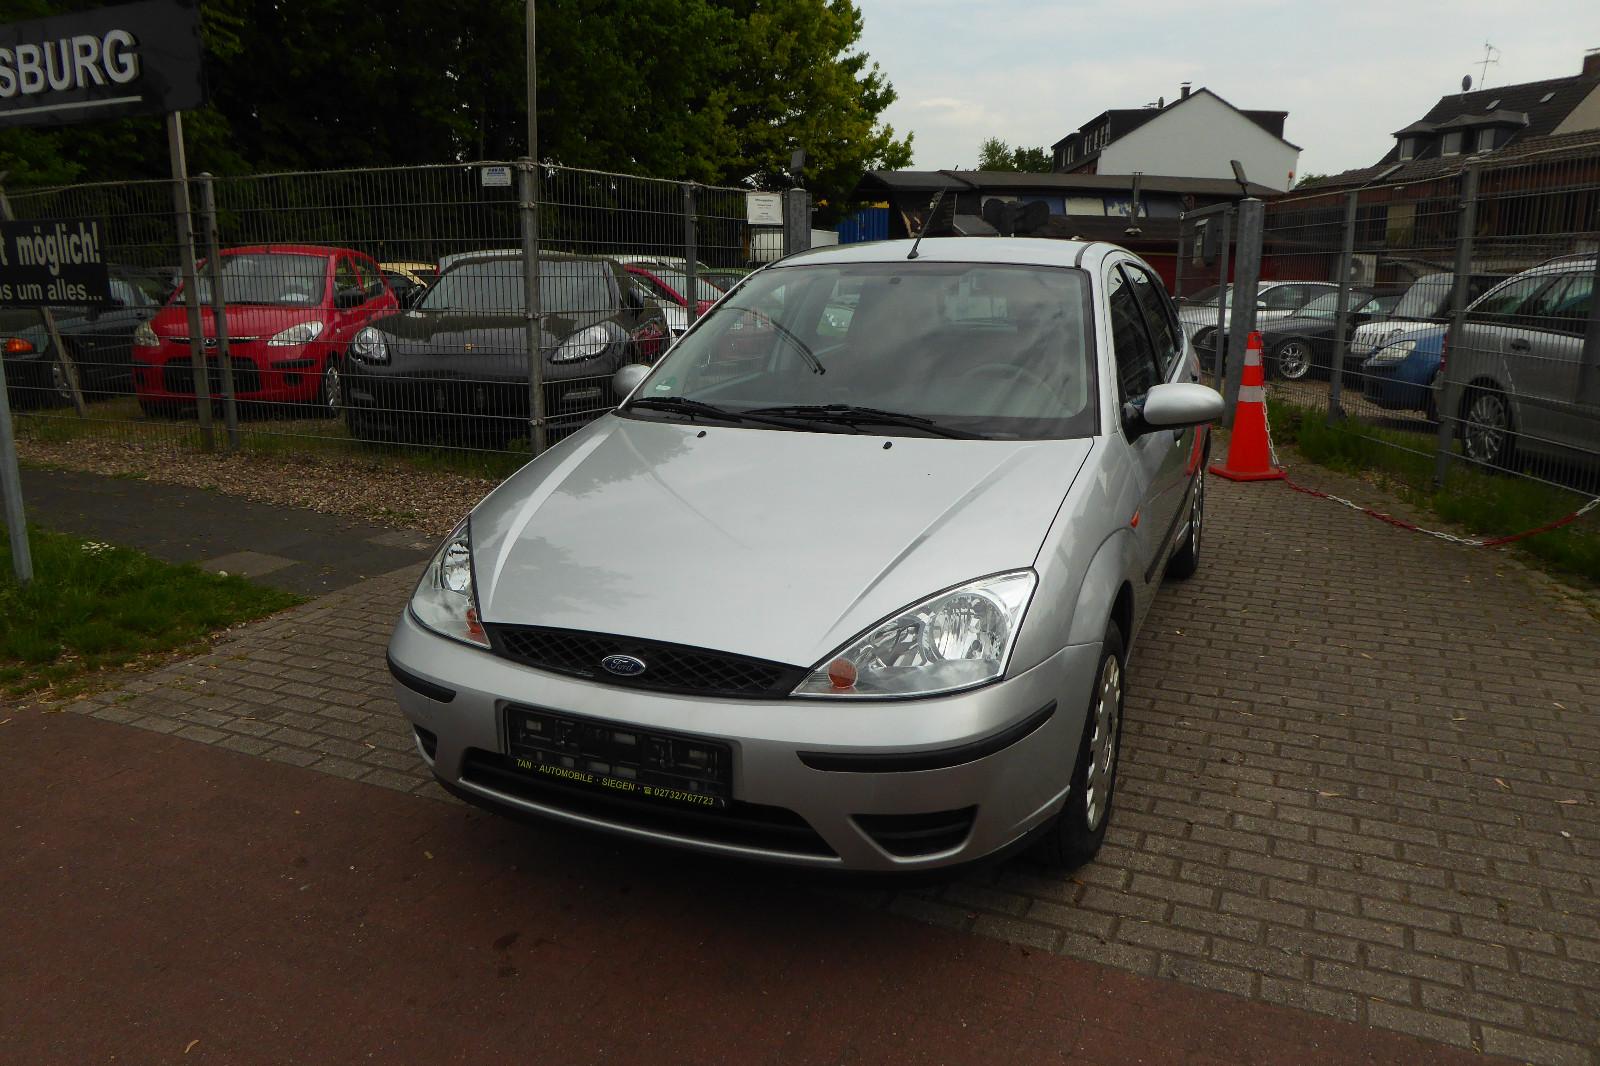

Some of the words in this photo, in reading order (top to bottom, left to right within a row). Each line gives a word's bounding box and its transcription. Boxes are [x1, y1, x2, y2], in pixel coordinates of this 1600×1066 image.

[0, 29, 141, 98] SBURG
[16, 221, 101, 276] möglich!
[0, 283, 13, 300] s
[16, 283, 43, 300] um
[47, 278, 103, 301] alles...
[611, 659, 634, 671] Ford
[515, 758, 532, 769] TAN
[538, 764, 594, 784] AUTOMOBILE
[602, 777, 635, 792] SIEGEN
[654, 788, 715, 807] 02732/767723
